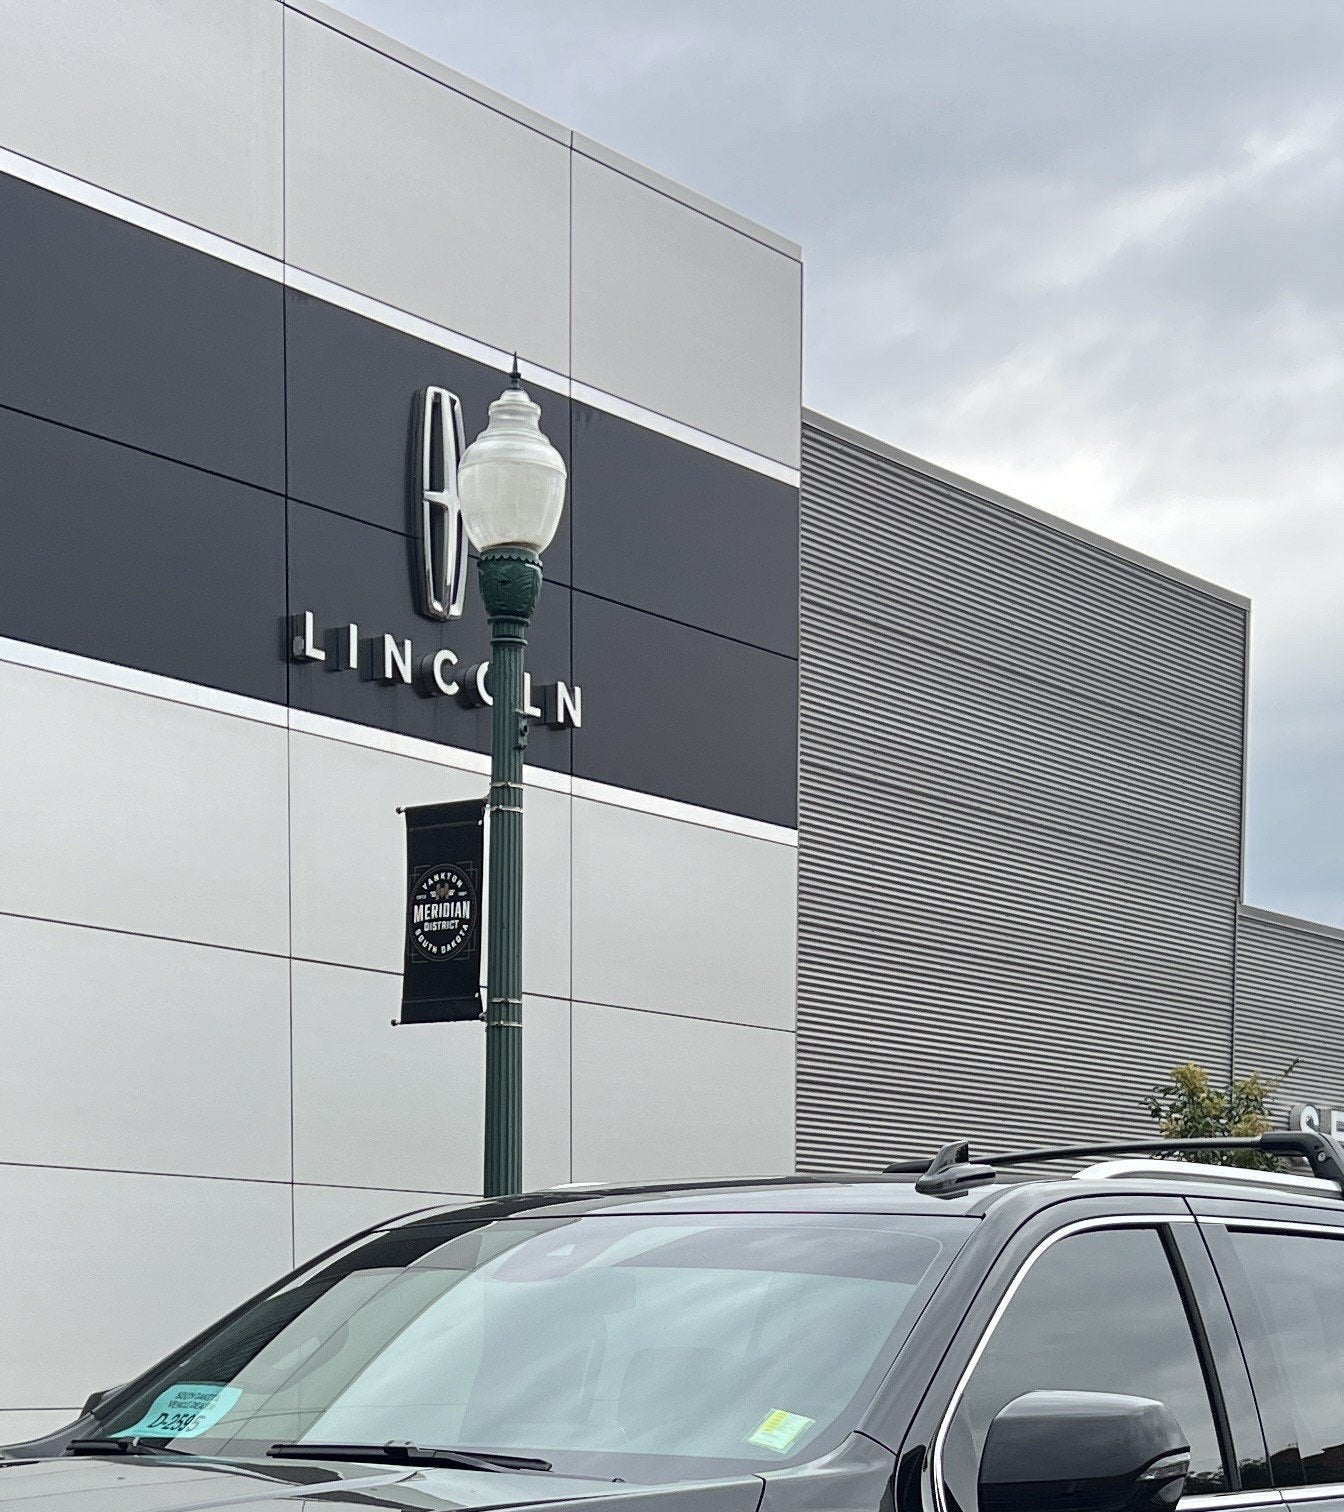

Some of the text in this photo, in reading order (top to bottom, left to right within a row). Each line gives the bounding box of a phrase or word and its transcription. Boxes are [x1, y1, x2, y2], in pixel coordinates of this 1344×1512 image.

[422, 872, 463, 890] YANKTON
[413, 901, 471, 924] MERIDIAN
[423, 919, 460, 932] DISTRICT
[415, 924, 469, 954] SOUTH DAKOTA
